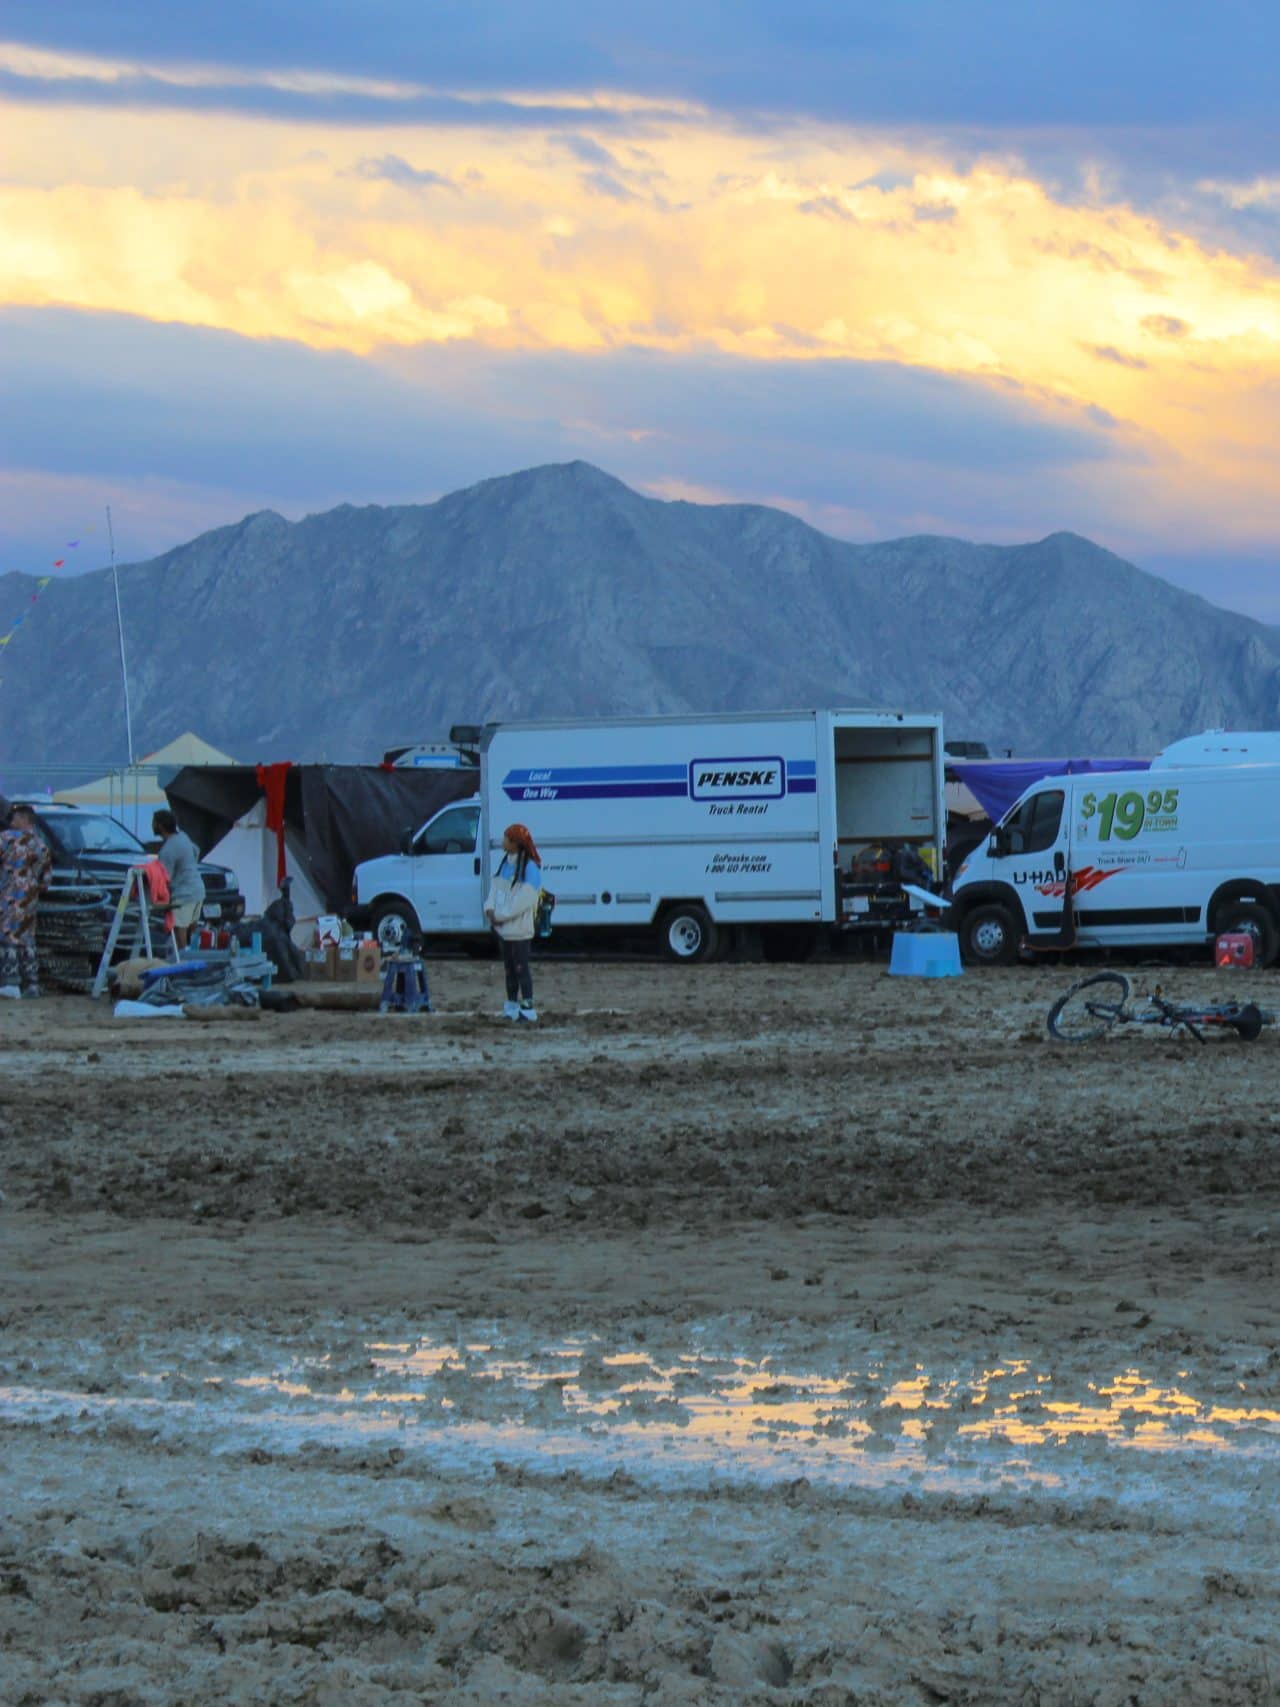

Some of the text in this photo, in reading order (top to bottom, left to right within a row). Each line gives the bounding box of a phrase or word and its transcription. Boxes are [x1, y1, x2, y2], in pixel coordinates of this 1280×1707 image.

[529, 770, 552, 781] Local
[697, 770, 777, 787] PENSKE
[523, 787, 559, 800] One Way
[708, 803, 768, 815] Truck Rental
